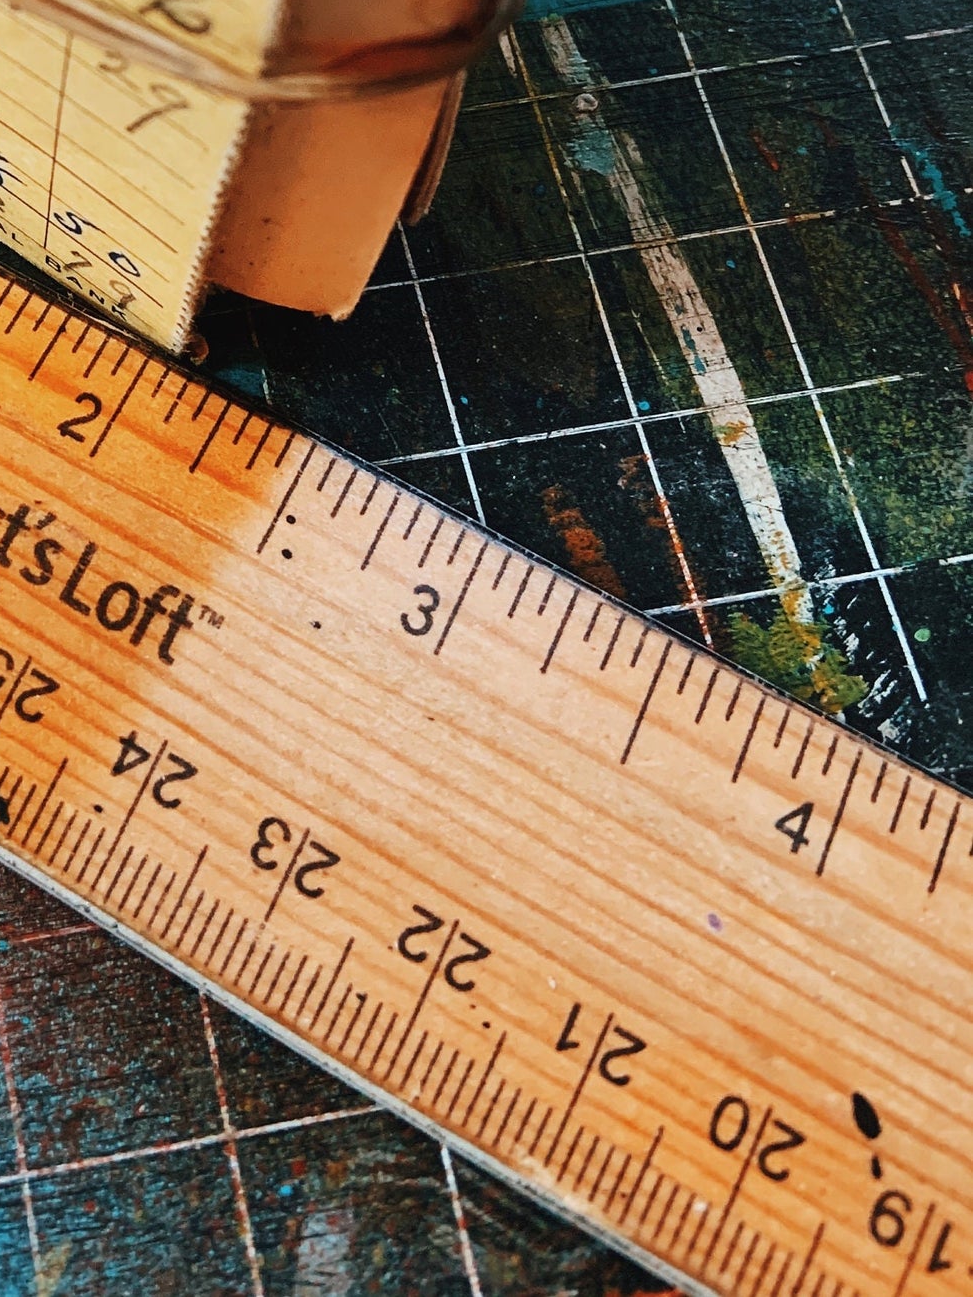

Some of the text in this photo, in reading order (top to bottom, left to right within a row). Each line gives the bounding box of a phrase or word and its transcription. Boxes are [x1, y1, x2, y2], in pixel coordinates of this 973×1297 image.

[45, 255, 128, 321] BANK
[57, 392, 103, 443] 2
[401, 584, 441, 636] 3
[774, 801, 814, 853] 4
